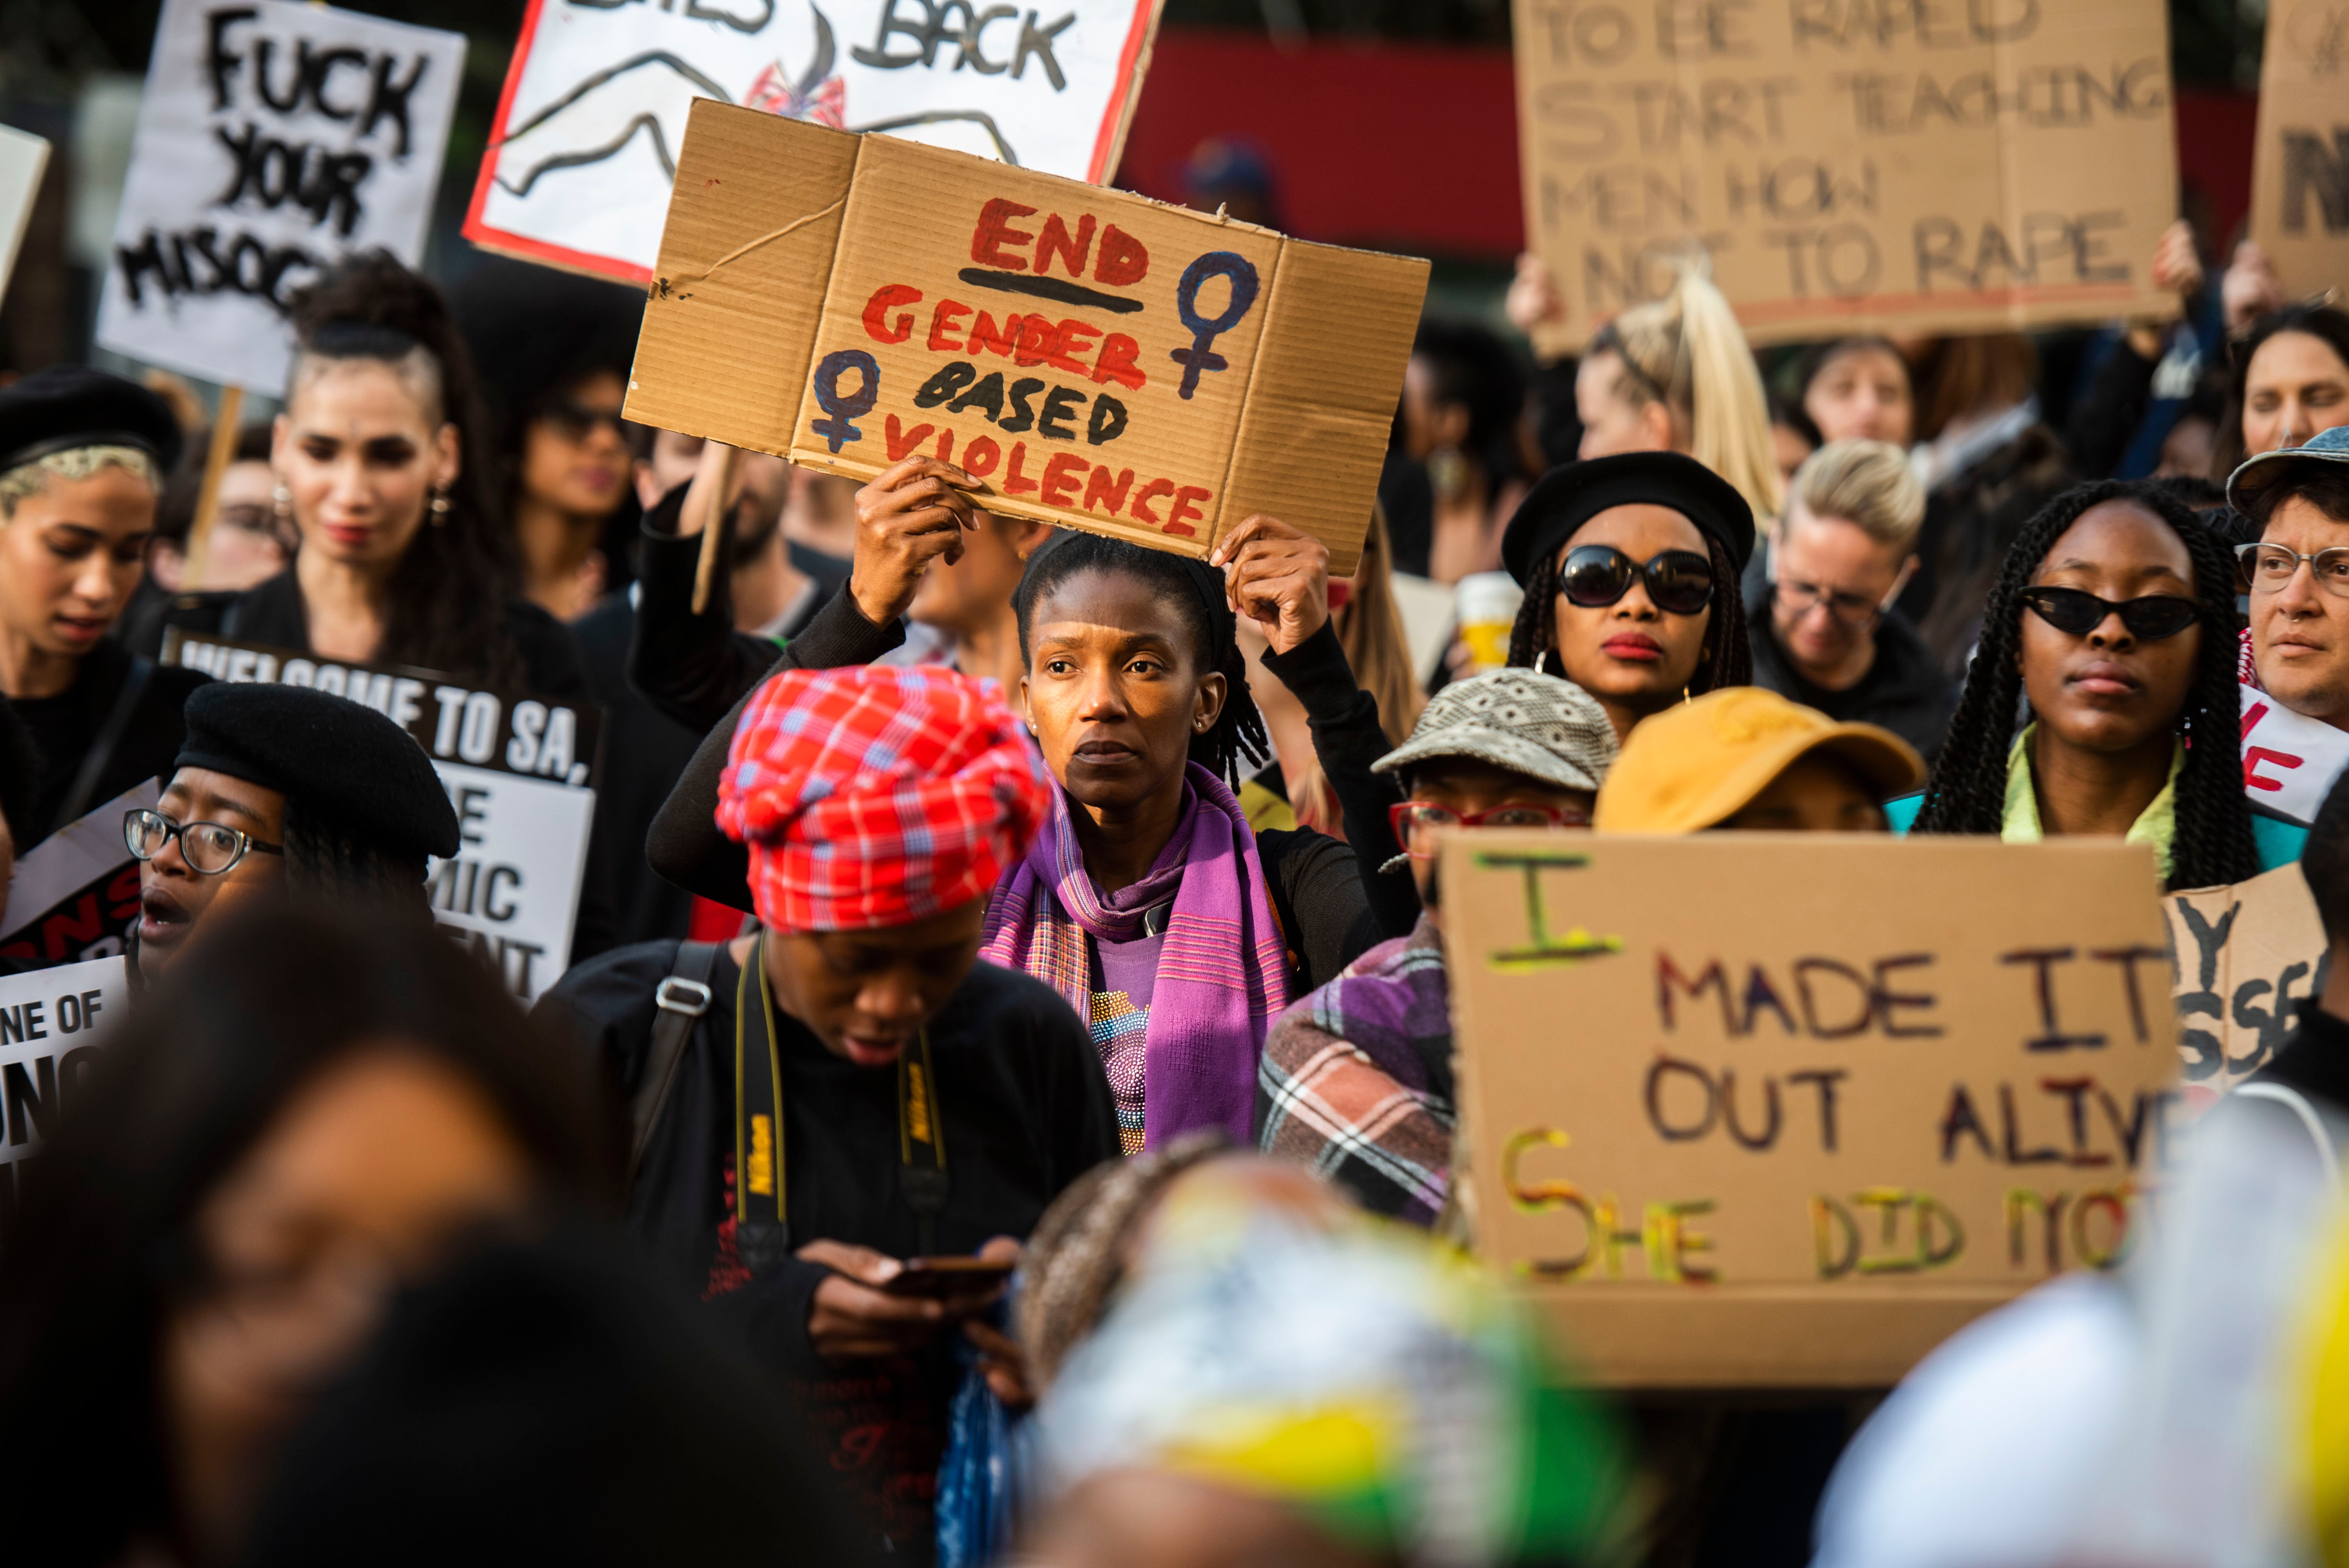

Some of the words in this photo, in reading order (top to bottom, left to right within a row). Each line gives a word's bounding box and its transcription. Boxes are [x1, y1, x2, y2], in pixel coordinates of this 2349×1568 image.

[207, 7, 430, 166] FUCK
[851, 0, 1076, 91] BACK
[1533, 0, 1641, 68] TO
[1653, 0, 1758, 62] BE
[1791, 0, 2041, 53] RAPED
[1535, 75, 1800, 162] START
[1829, 55, 2167, 136] TEACHING
[214, 122, 373, 237] YOUR
[1542, 162, 1698, 239] MEN
[1722, 156, 1880, 223] HOW
[970, 198, 1149, 286] END
[1759, 222, 1882, 300] TO
[1912, 208, 2132, 292] RAPE
[861, 283, 1146, 391] GENDER
[913, 361, 1128, 446] BASED
[884, 413, 1212, 537] VIOLENCE
[433, 684, 501, 764] TO
[506, 700, 590, 785] SA,
[1474, 849, 1623, 973] I
[55, 989, 102, 1034] OF
[1652, 947, 1944, 1042] MADE
[1998, 944, 2172, 1053] IT
[1644, 1048, 1849, 1155] OUT
[1501, 1126, 1724, 1286] SHE
[1810, 1183, 1966, 1285] DID
